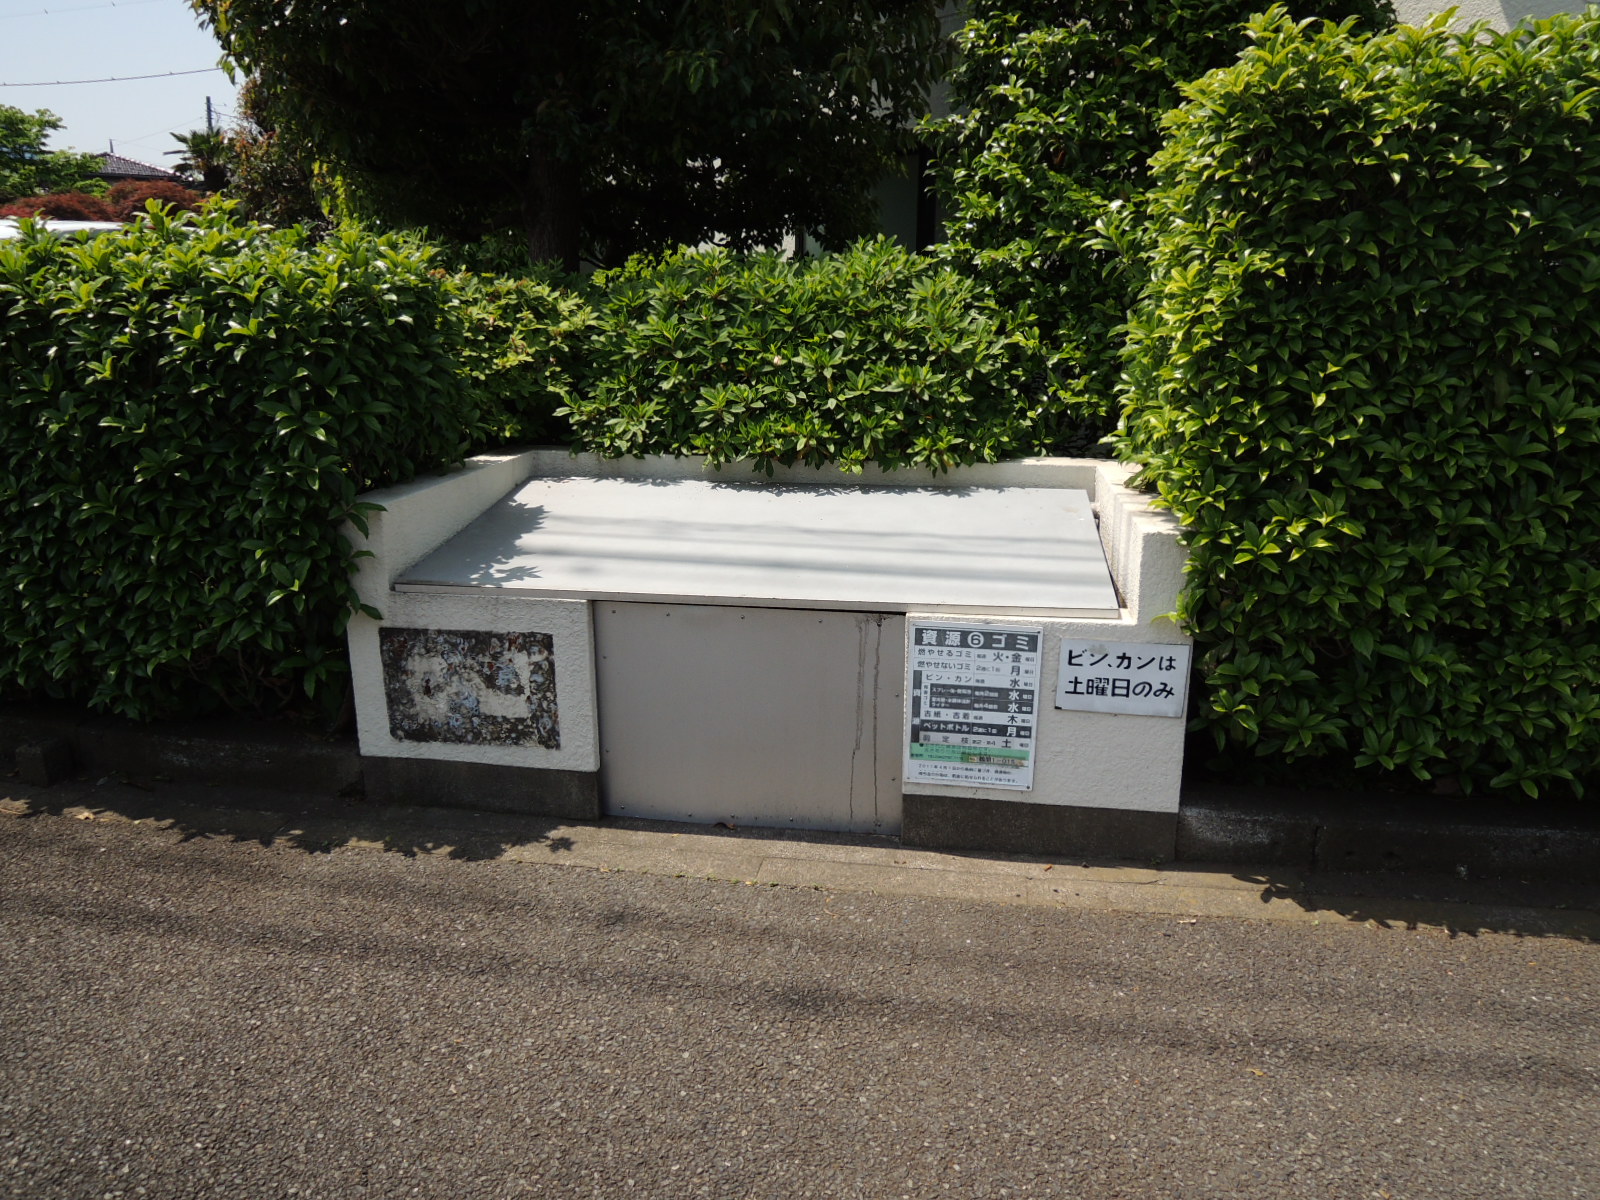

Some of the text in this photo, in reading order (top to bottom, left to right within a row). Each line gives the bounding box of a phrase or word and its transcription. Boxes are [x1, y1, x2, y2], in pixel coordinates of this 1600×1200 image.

[917, 648, 972, 658] 燃やせるゴミ
[917, 660, 971, 671] 燃やせないゴミ
[1010, 665, 1021, 676] 月
[1009, 678, 1020, 688] 水
[1065, 676, 1175, 699] 土曜日のみ
[1008, 690, 1020, 700] 水
[1007, 702, 1019, 712] 水
[1007, 714, 1018, 724] 木
[923, 721, 970, 732] ペットボトル
[1006, 726, 1017, 737] 月
[1001, 739, 1012, 749] 土
